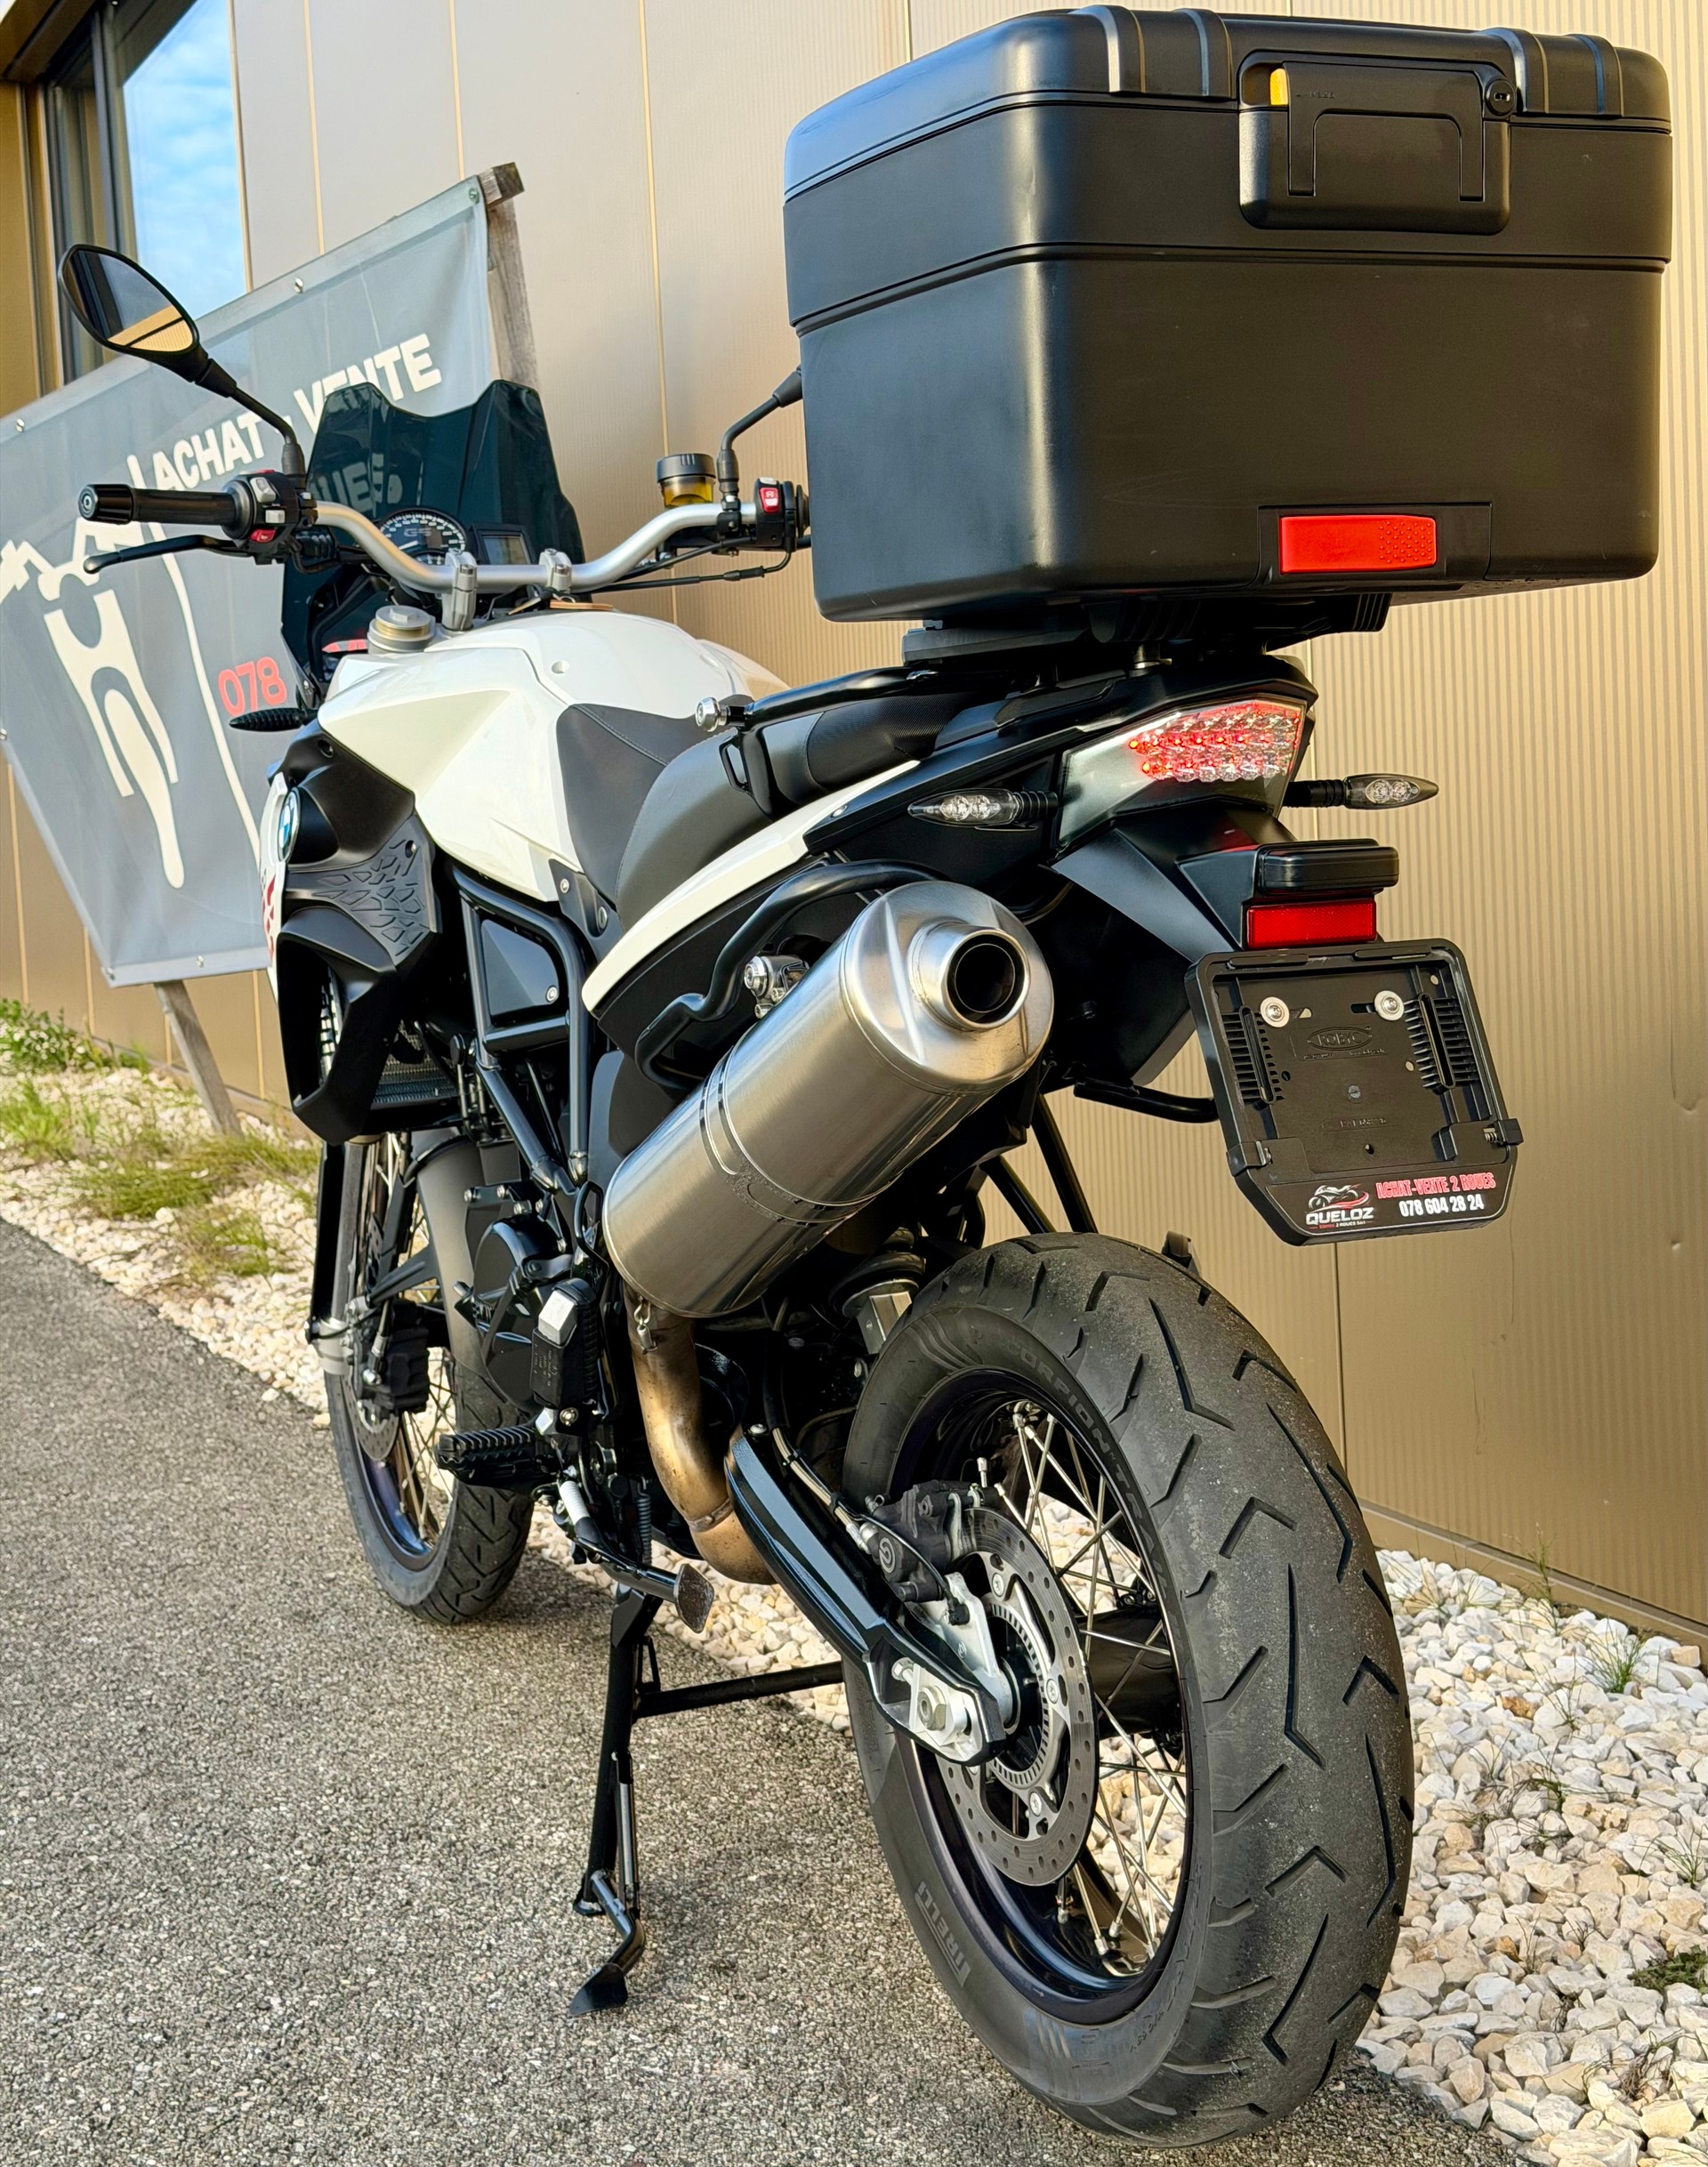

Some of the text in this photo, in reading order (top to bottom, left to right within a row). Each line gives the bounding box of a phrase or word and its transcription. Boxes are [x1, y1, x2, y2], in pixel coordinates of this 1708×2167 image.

[152, 412, 265, 490] ACHAT
[403, 527, 432, 537] GS
[218, 657, 287, 717] 078
[1449, 1175, 1460, 1192] 2
[1459, 1172, 1496, 1191] ROUES
[1305, 1206, 1374, 1226] QUELOZ
[1398, 1193, 1485, 1217] 078 604 28 24
[914, 1881, 971, 1988] PIRELLI
